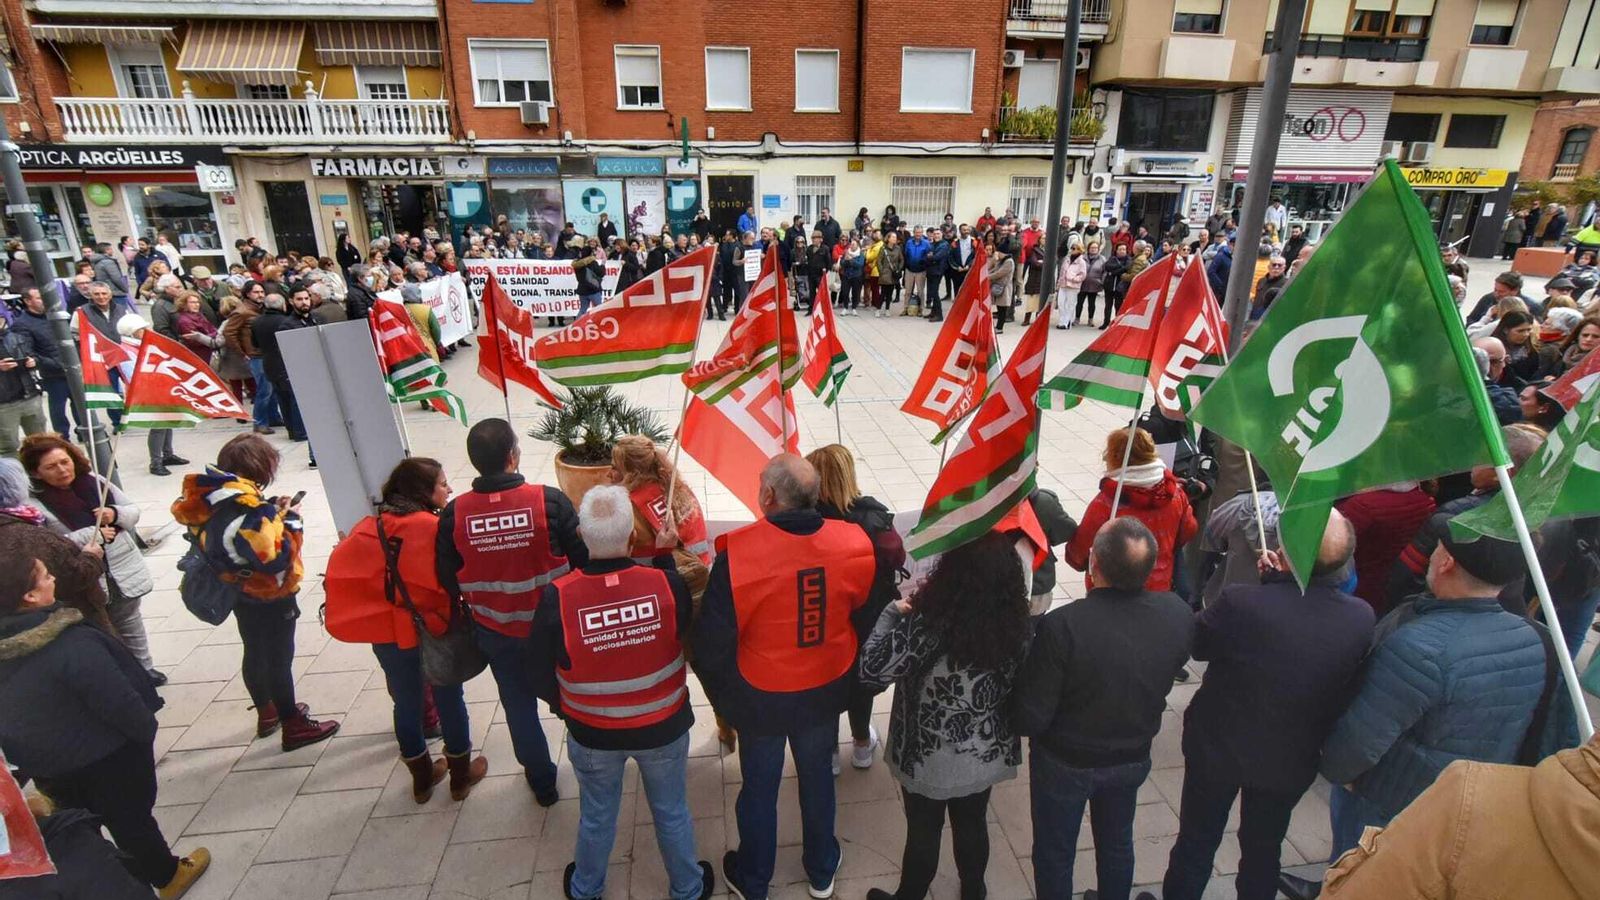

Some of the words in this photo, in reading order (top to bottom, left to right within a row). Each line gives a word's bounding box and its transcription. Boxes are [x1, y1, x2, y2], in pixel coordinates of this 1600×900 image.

[78, 148, 184, 165] ARGÜELLES
[311, 158, 435, 176] FARMACIA
[1408, 170, 1453, 184] COMPRO
[1455, 171, 1479, 184] ORO
[496, 264, 530, 275] ESTÁN
[533, 266, 574, 276] DEJAND
[531, 302, 547, 314] NO
[549, 301, 562, 312] LO
[471, 513, 529, 534] CCOO
[470, 536, 498, 546] sanidad
[504, 532, 535, 541] sectores
[477, 541, 530, 552] sociosanitarios
[585, 601, 655, 630] CCOO
[583, 631, 617, 645] sanidad
[618, 631, 625, 639] y
[626, 622, 662, 636] sectores
[592, 634, 656, 653] sociosanitarios
